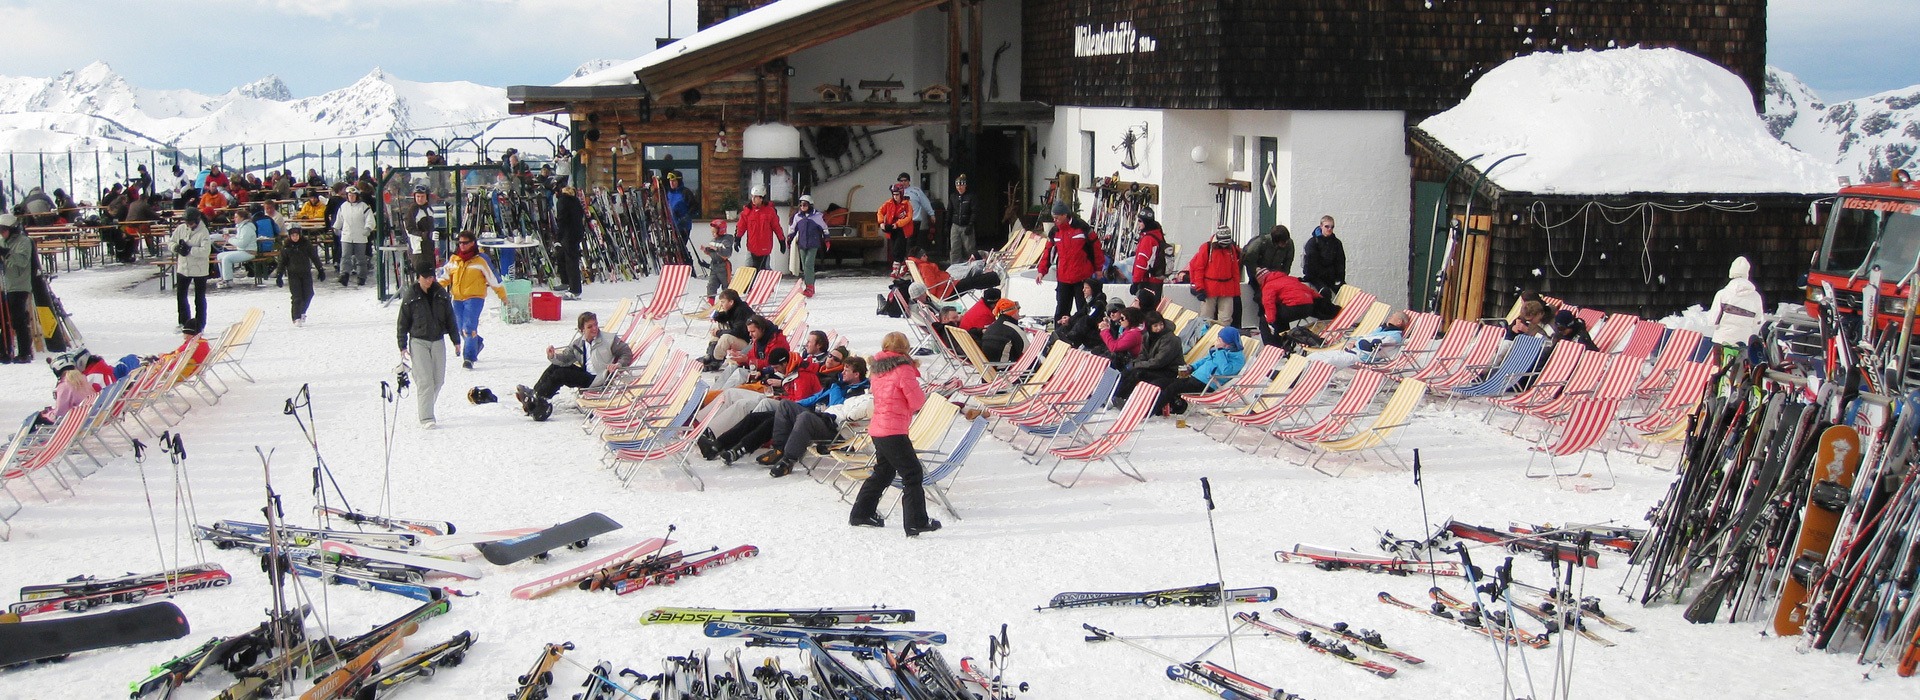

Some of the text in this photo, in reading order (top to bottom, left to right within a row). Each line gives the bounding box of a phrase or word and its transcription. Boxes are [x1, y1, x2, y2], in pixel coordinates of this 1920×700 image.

[1074, 21, 1136, 57] Wildenkarhütte
[648, 613, 726, 623] FISCHER
[1172, 664, 1228, 694] ATOMIC
